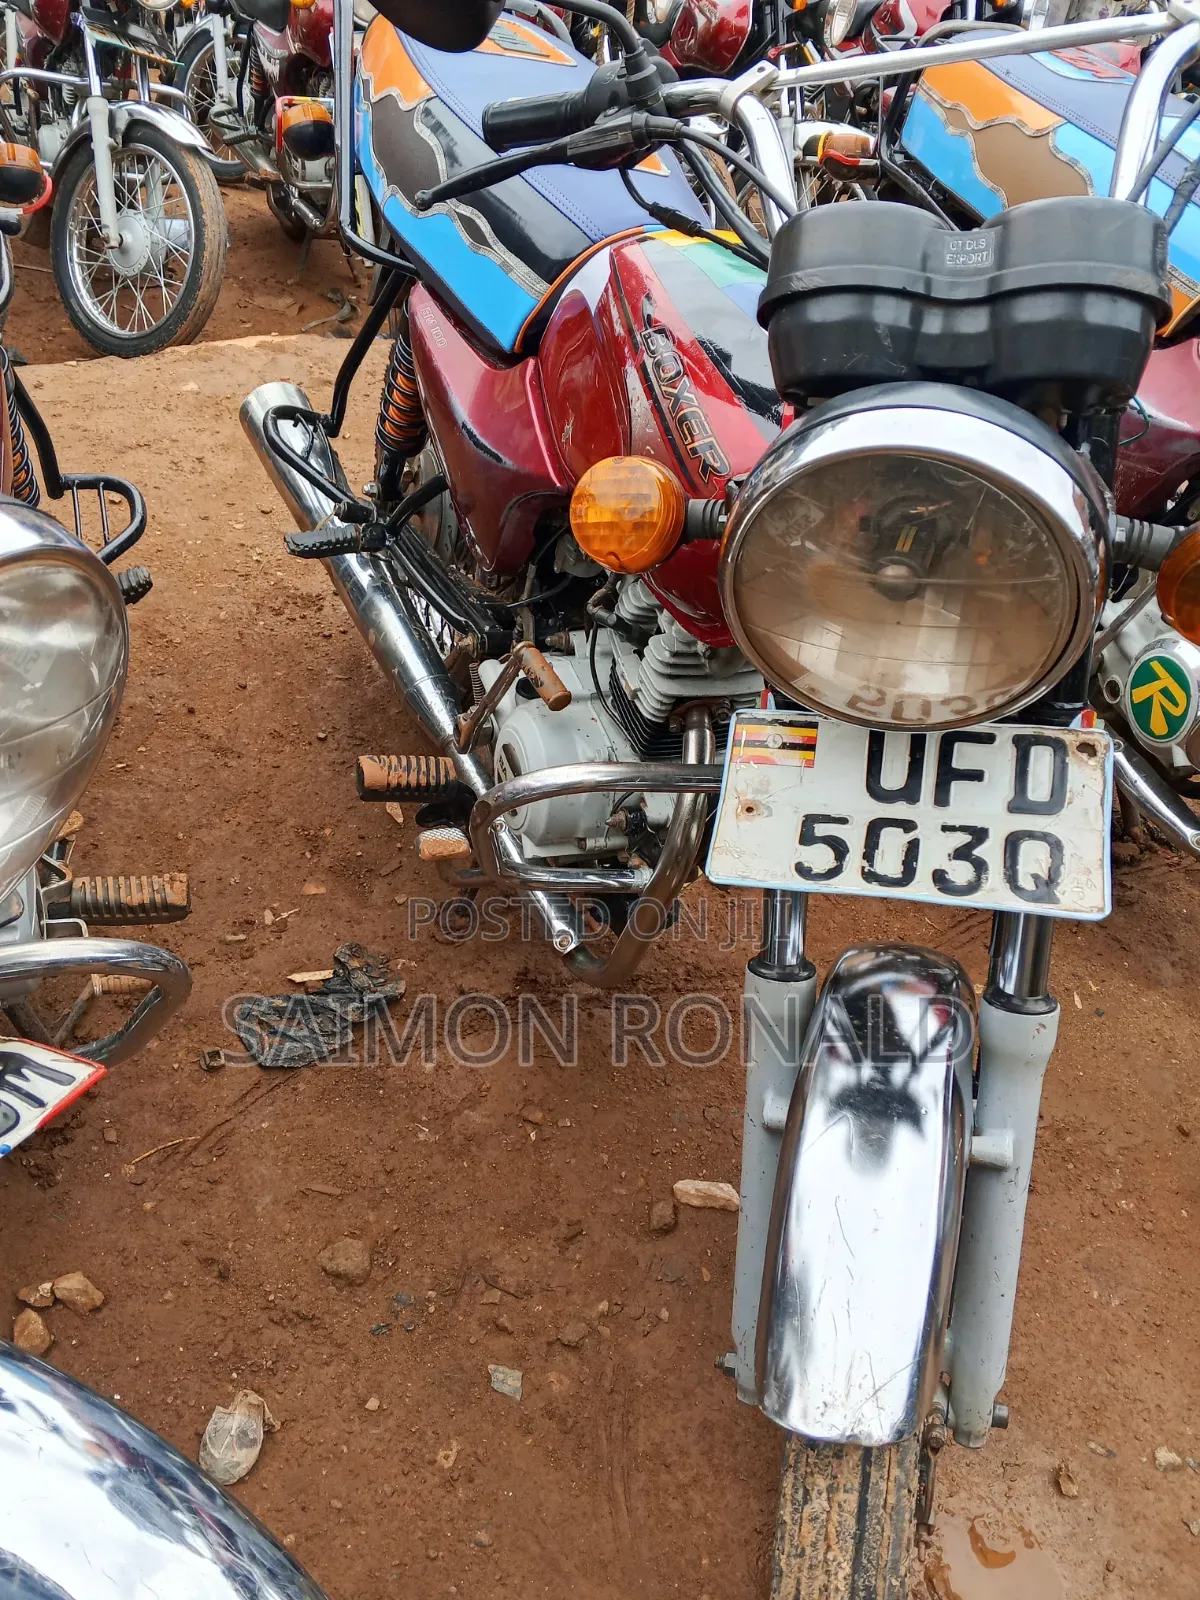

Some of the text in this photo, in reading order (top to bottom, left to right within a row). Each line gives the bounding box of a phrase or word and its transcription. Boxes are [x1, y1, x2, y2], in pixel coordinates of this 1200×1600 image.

[946, 251, 989, 265] EXPORT
[639, 325, 732, 484] BOXER
[866, 730, 1069, 815] UFD
[794, 813, 1066, 904] 503Q
